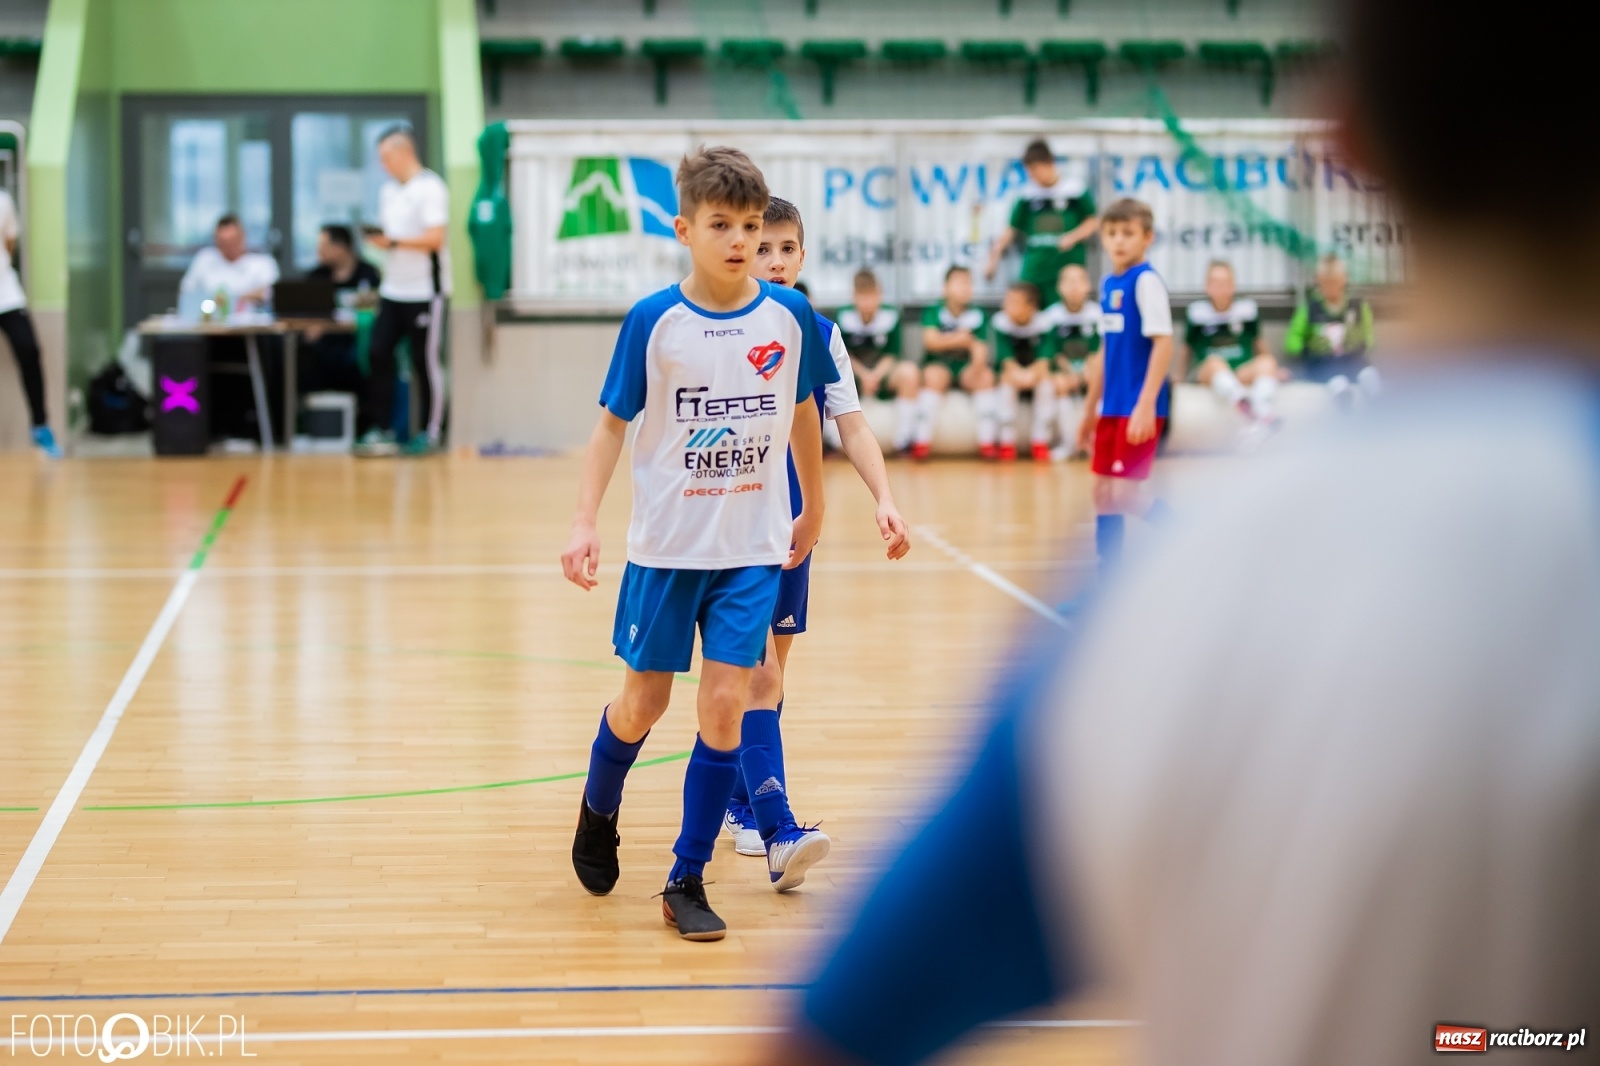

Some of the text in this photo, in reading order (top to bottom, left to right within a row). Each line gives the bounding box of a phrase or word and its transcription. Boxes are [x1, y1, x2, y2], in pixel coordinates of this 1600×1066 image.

[721, 434, 771, 448] BESKID
[684, 445, 770, 470] ENERGY
[690, 466, 756, 480] FOTOWOLTAIKA
